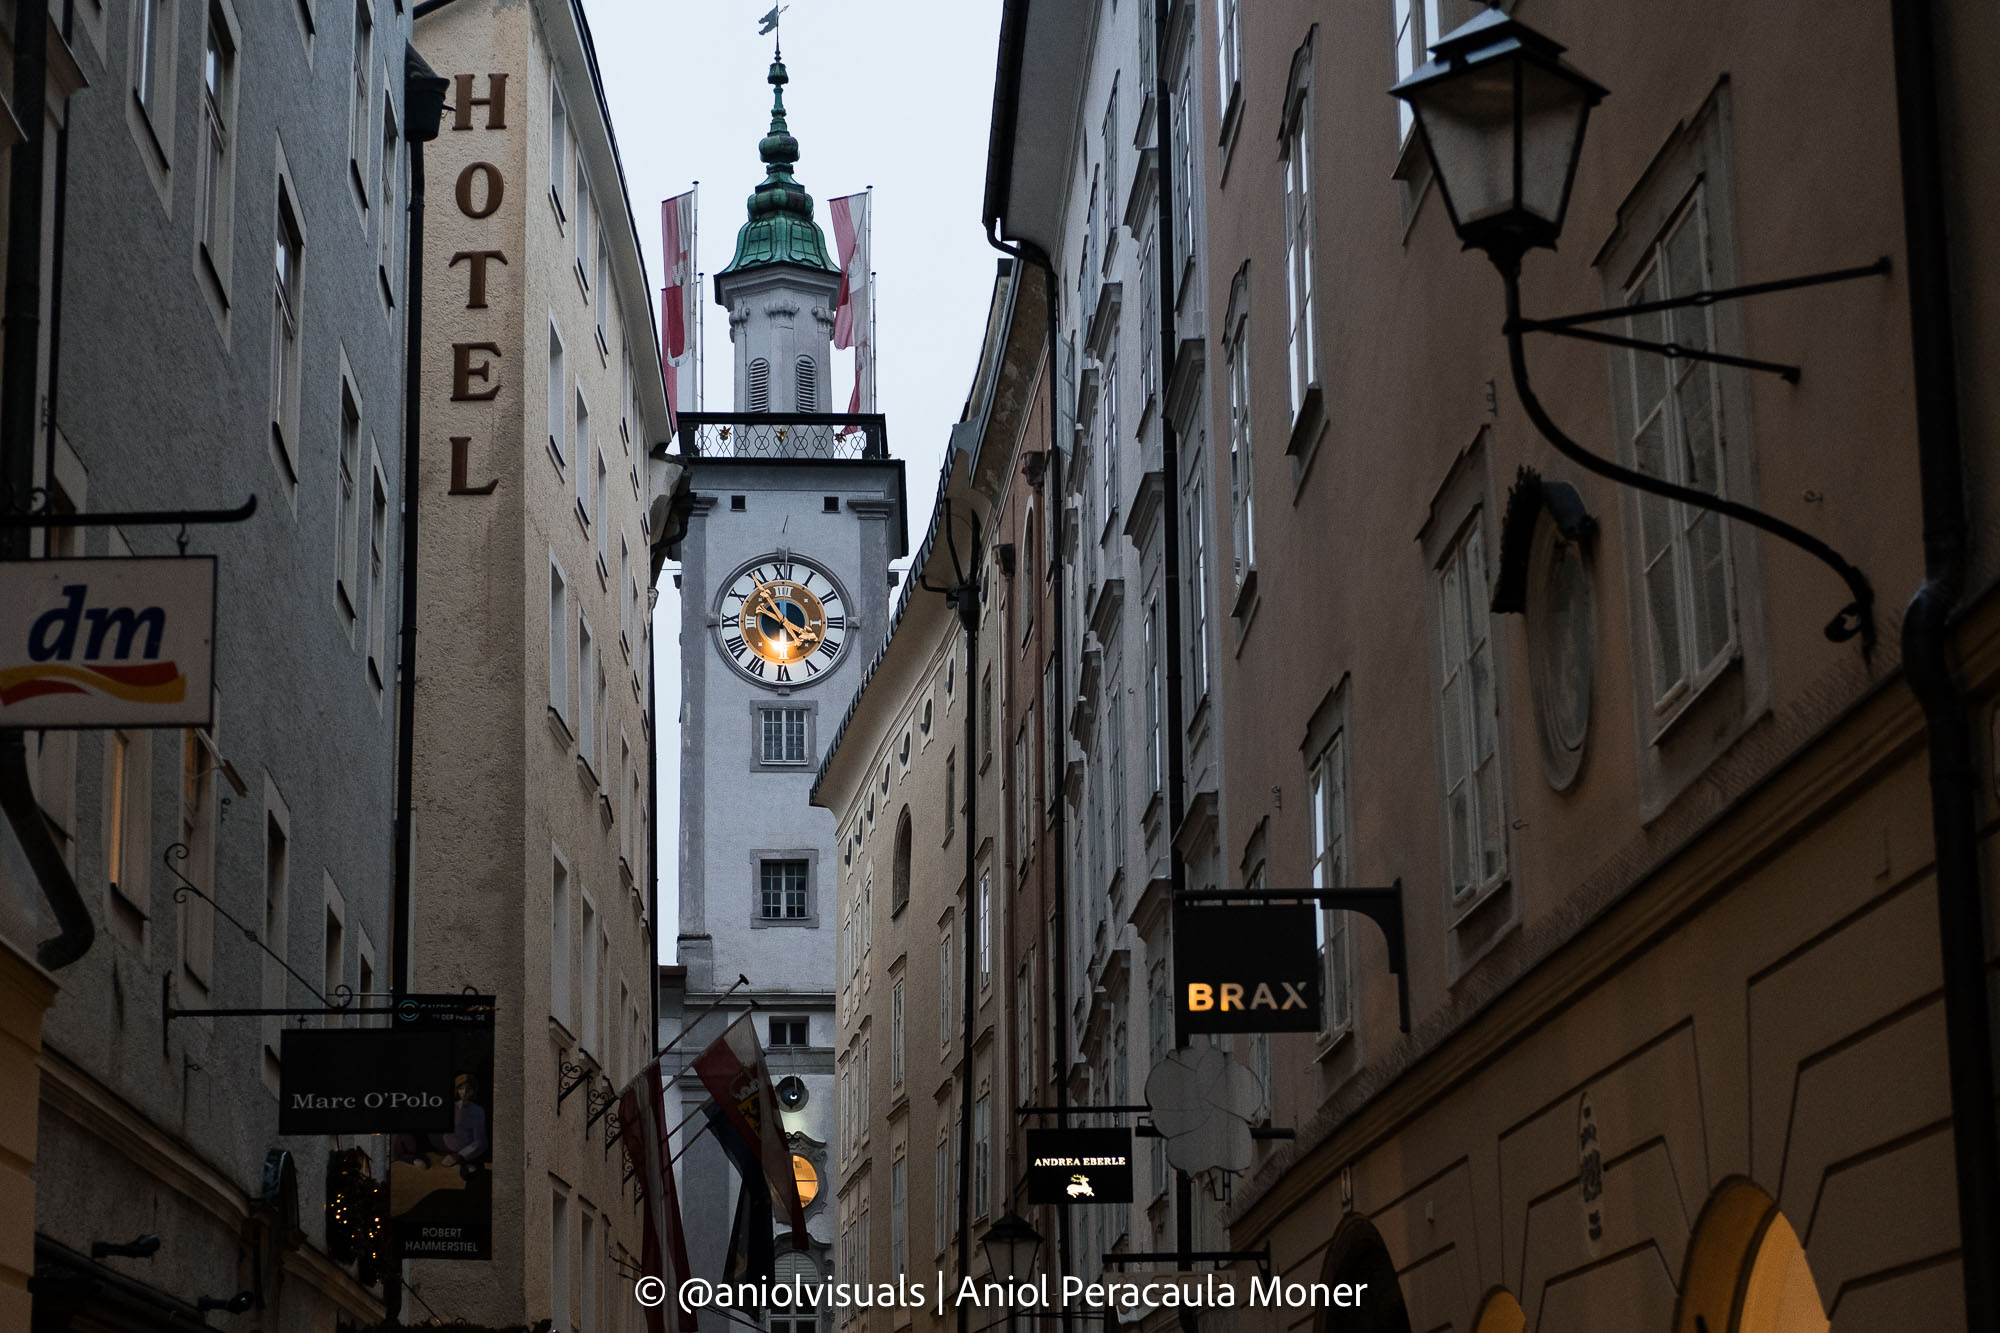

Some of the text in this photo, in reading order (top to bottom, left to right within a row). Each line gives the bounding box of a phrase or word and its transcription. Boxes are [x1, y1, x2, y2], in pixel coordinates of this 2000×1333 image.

[448, 73, 508, 496] HOTEL
[803, 570, 816, 587] I
[728, 587, 748, 605] X
[819, 589, 838, 606] II
[28, 584, 166, 662] dm
[722, 613, 740, 629] IX
[827, 615, 844, 631] III
[725, 634, 748, 661] VIII
[817, 637, 841, 660] IIII
[745, 656, 765, 677] VII
[775, 664, 792, 681] VI
[805, 659, 820, 677] V
[1188, 982, 1308, 1011] BRAX
[291, 1092, 443, 1109] Marc O'Polo
[1034, 1157, 1126, 1166] ANDREA EBERLE
[421, 1227, 463, 1238] ROBERT
[404, 1241, 479, 1253] HAMMERSTIEL
